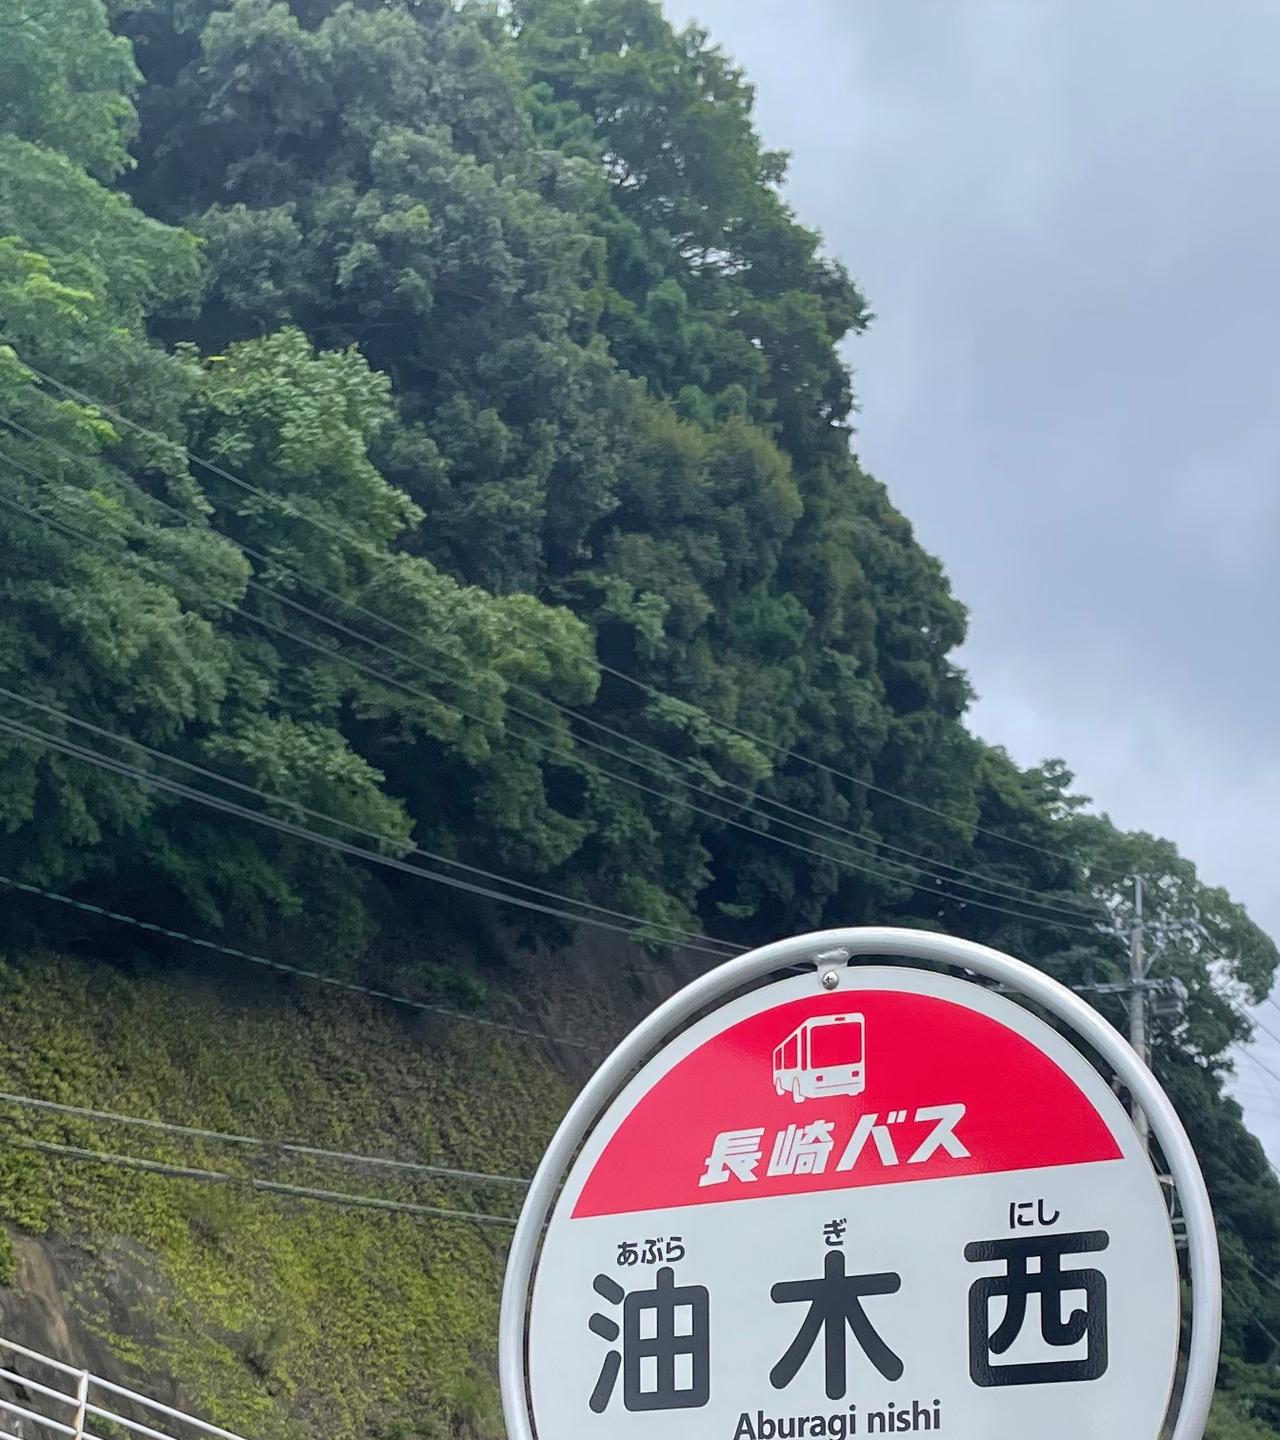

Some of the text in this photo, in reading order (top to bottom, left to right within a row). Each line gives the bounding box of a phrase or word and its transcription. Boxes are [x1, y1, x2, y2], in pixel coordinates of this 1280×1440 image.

[698, 1103, 971, 1187] 長崎バス
[616, 1199, 1061, 1267] あぶら ぎ にし
[588, 1230, 1110, 1414] 油木西
[867, 1398, 941, 1434] nishi
